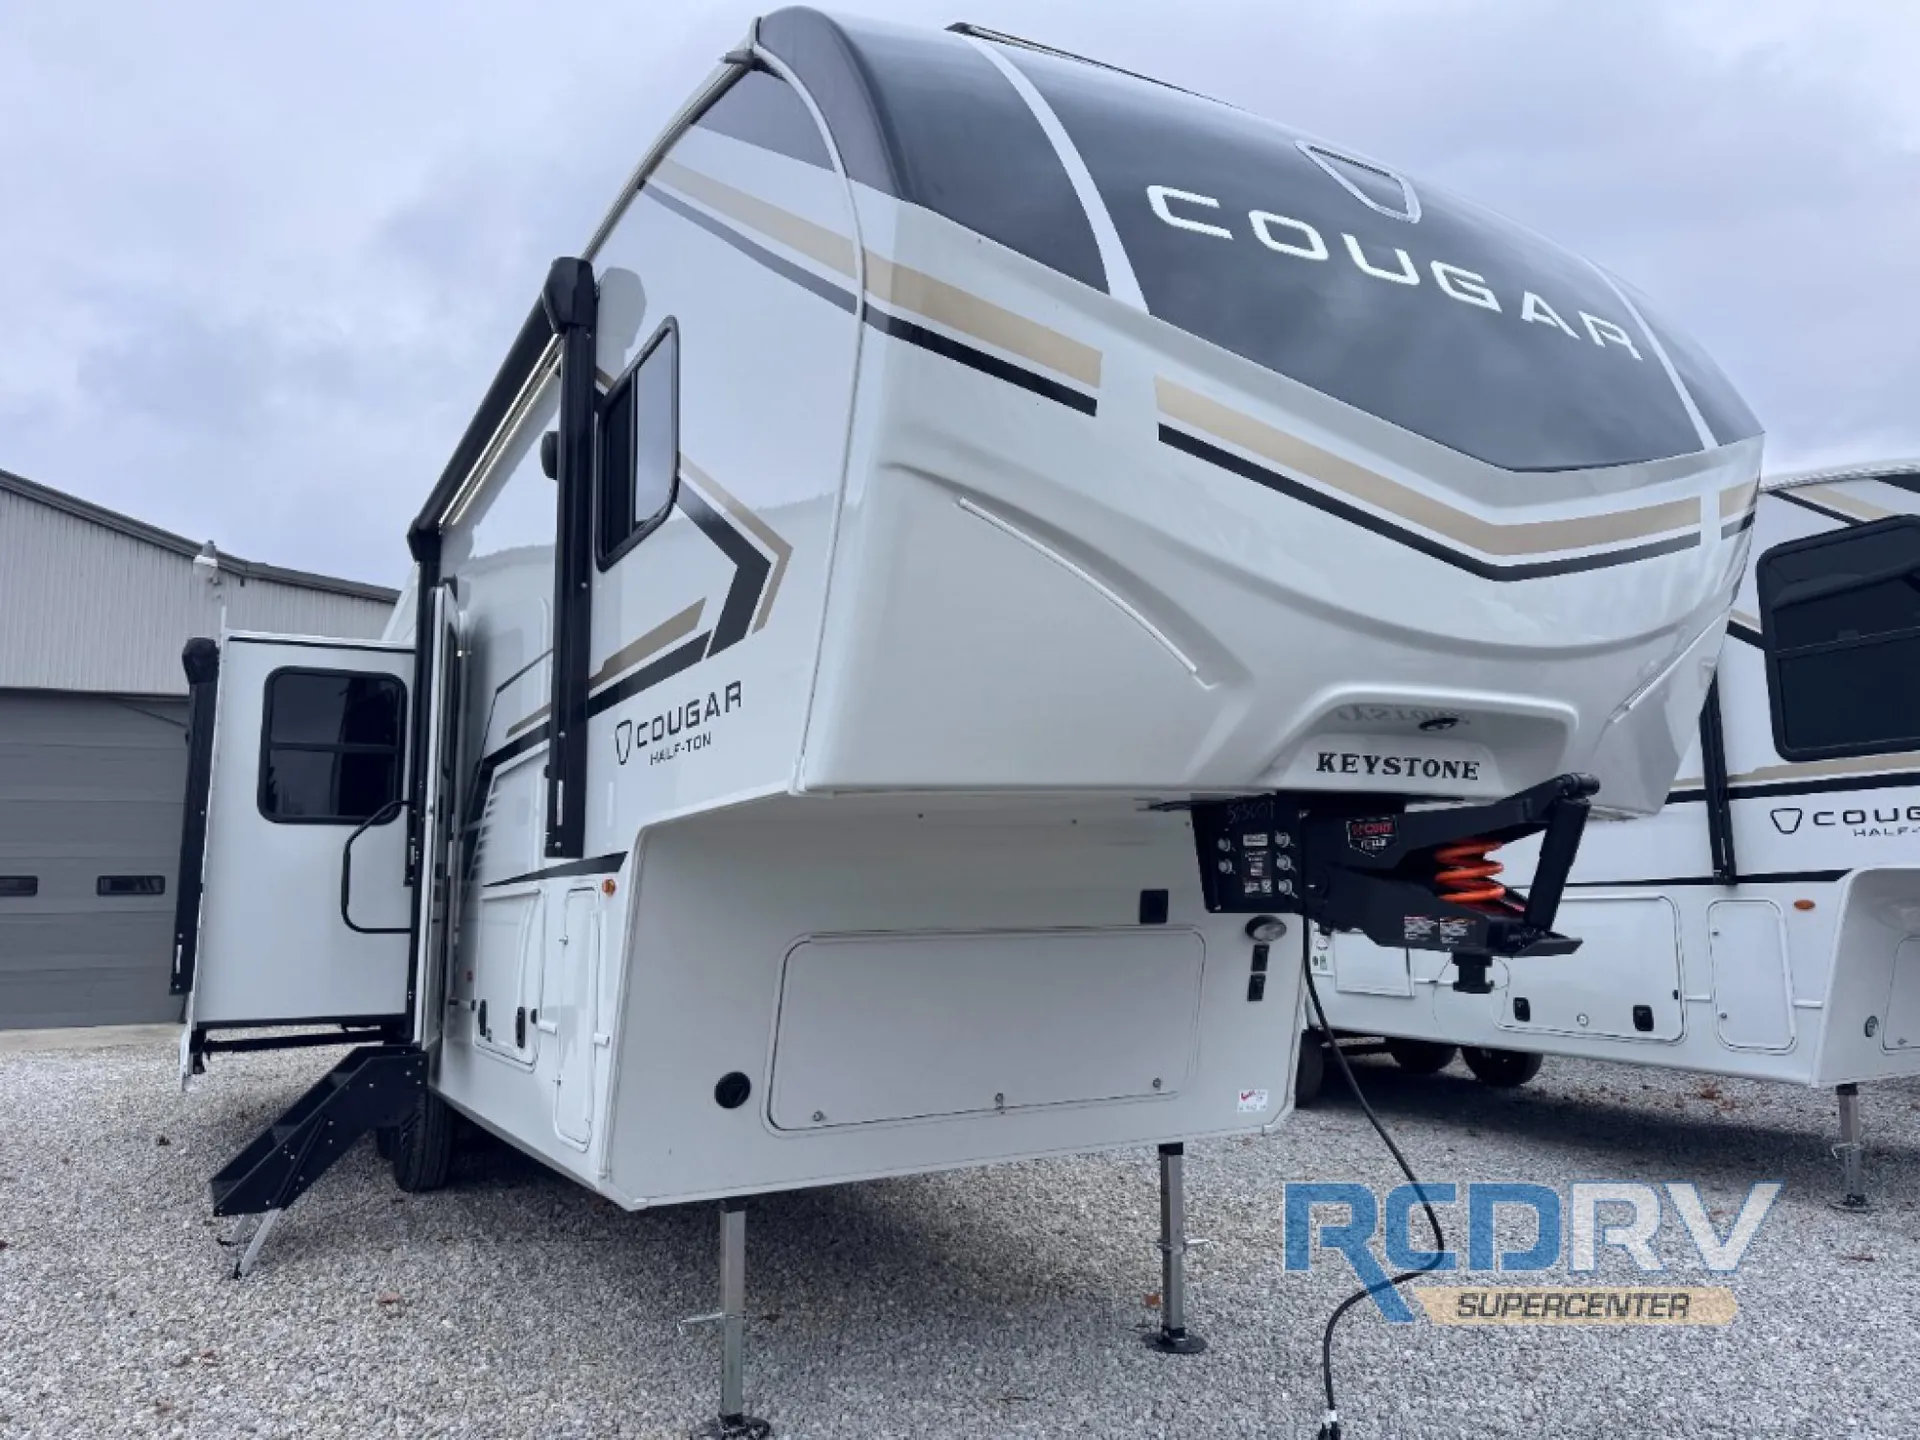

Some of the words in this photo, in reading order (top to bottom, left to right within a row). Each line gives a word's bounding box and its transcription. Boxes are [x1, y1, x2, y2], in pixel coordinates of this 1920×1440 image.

[1146, 184, 1643, 361] COUGAR
[636, 680, 742, 749] COUGAR
[649, 731, 712, 766] HALF-TON
[1315, 751, 1481, 781] KEYSTONE
[1812, 805, 1920, 827] COUG
[1853, 826, 1920, 837] HALF-
